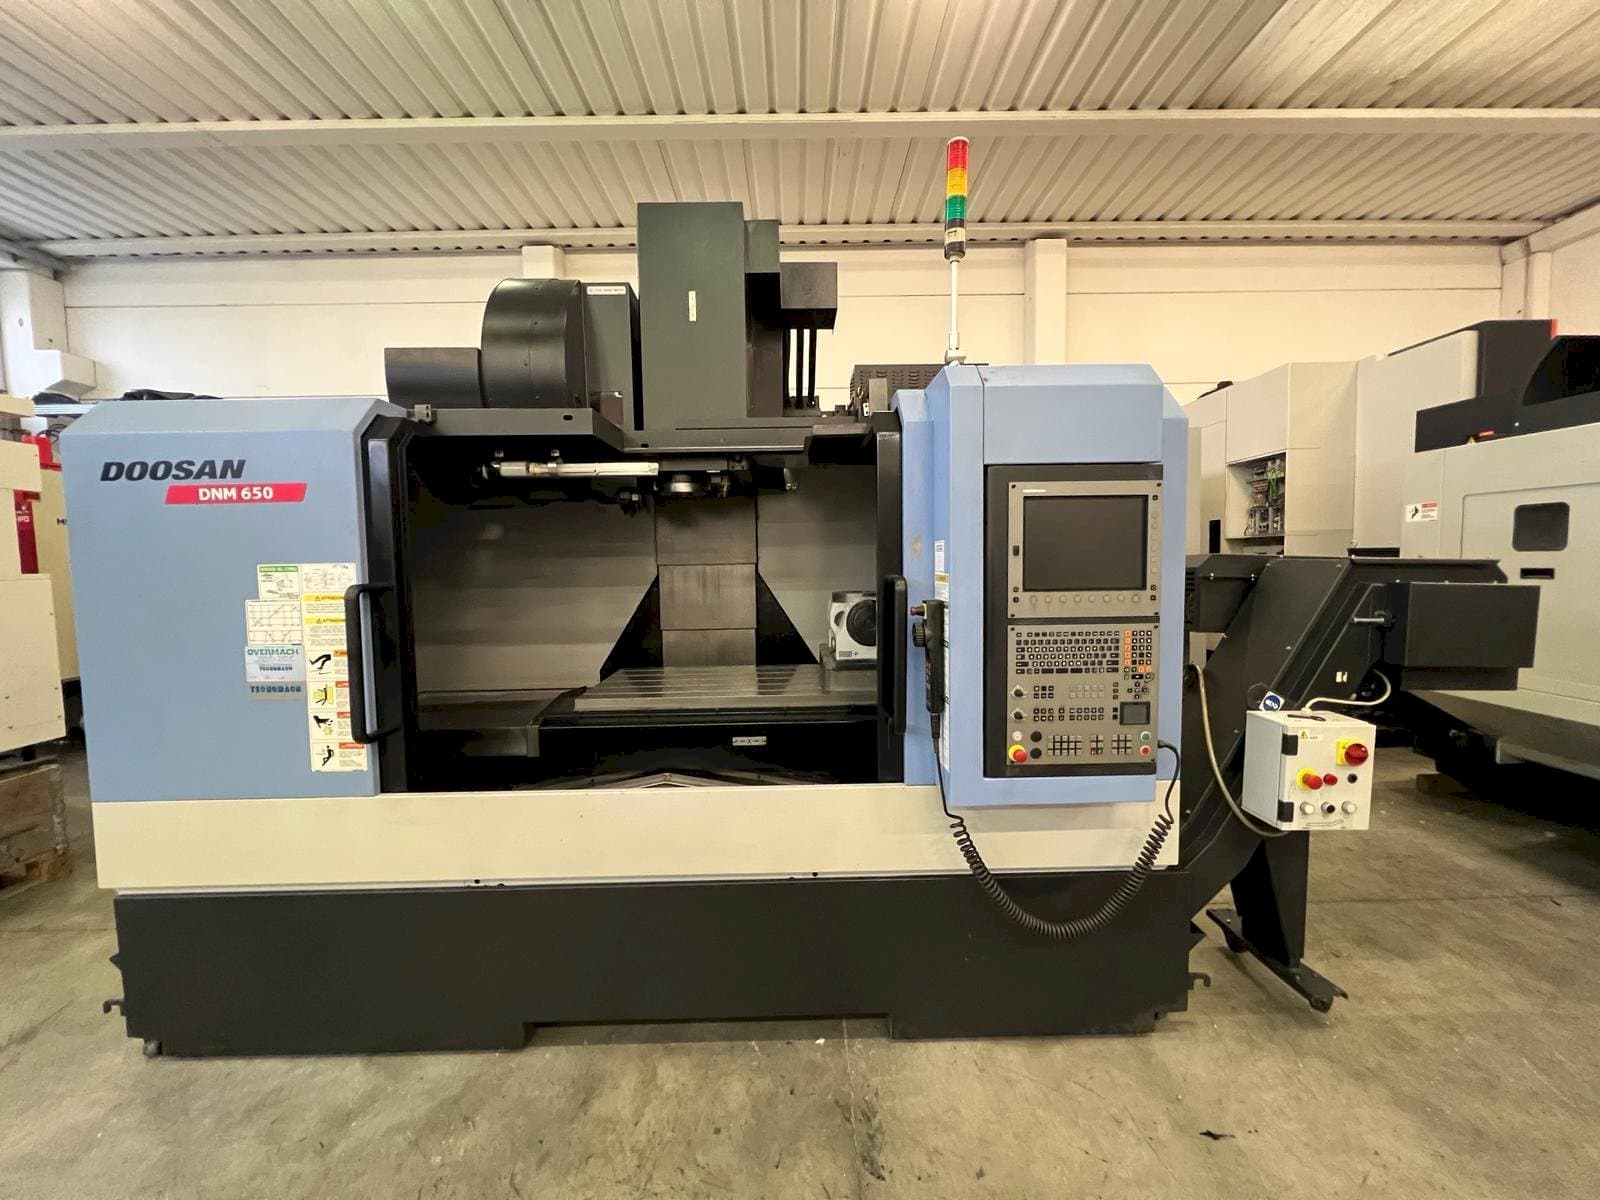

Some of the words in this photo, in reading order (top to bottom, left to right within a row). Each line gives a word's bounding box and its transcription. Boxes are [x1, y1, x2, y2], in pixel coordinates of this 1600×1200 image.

[100, 459, 246, 482] DOOSAN
[198, 487, 237, 500] DNM
[240, 487, 274, 500] 650
